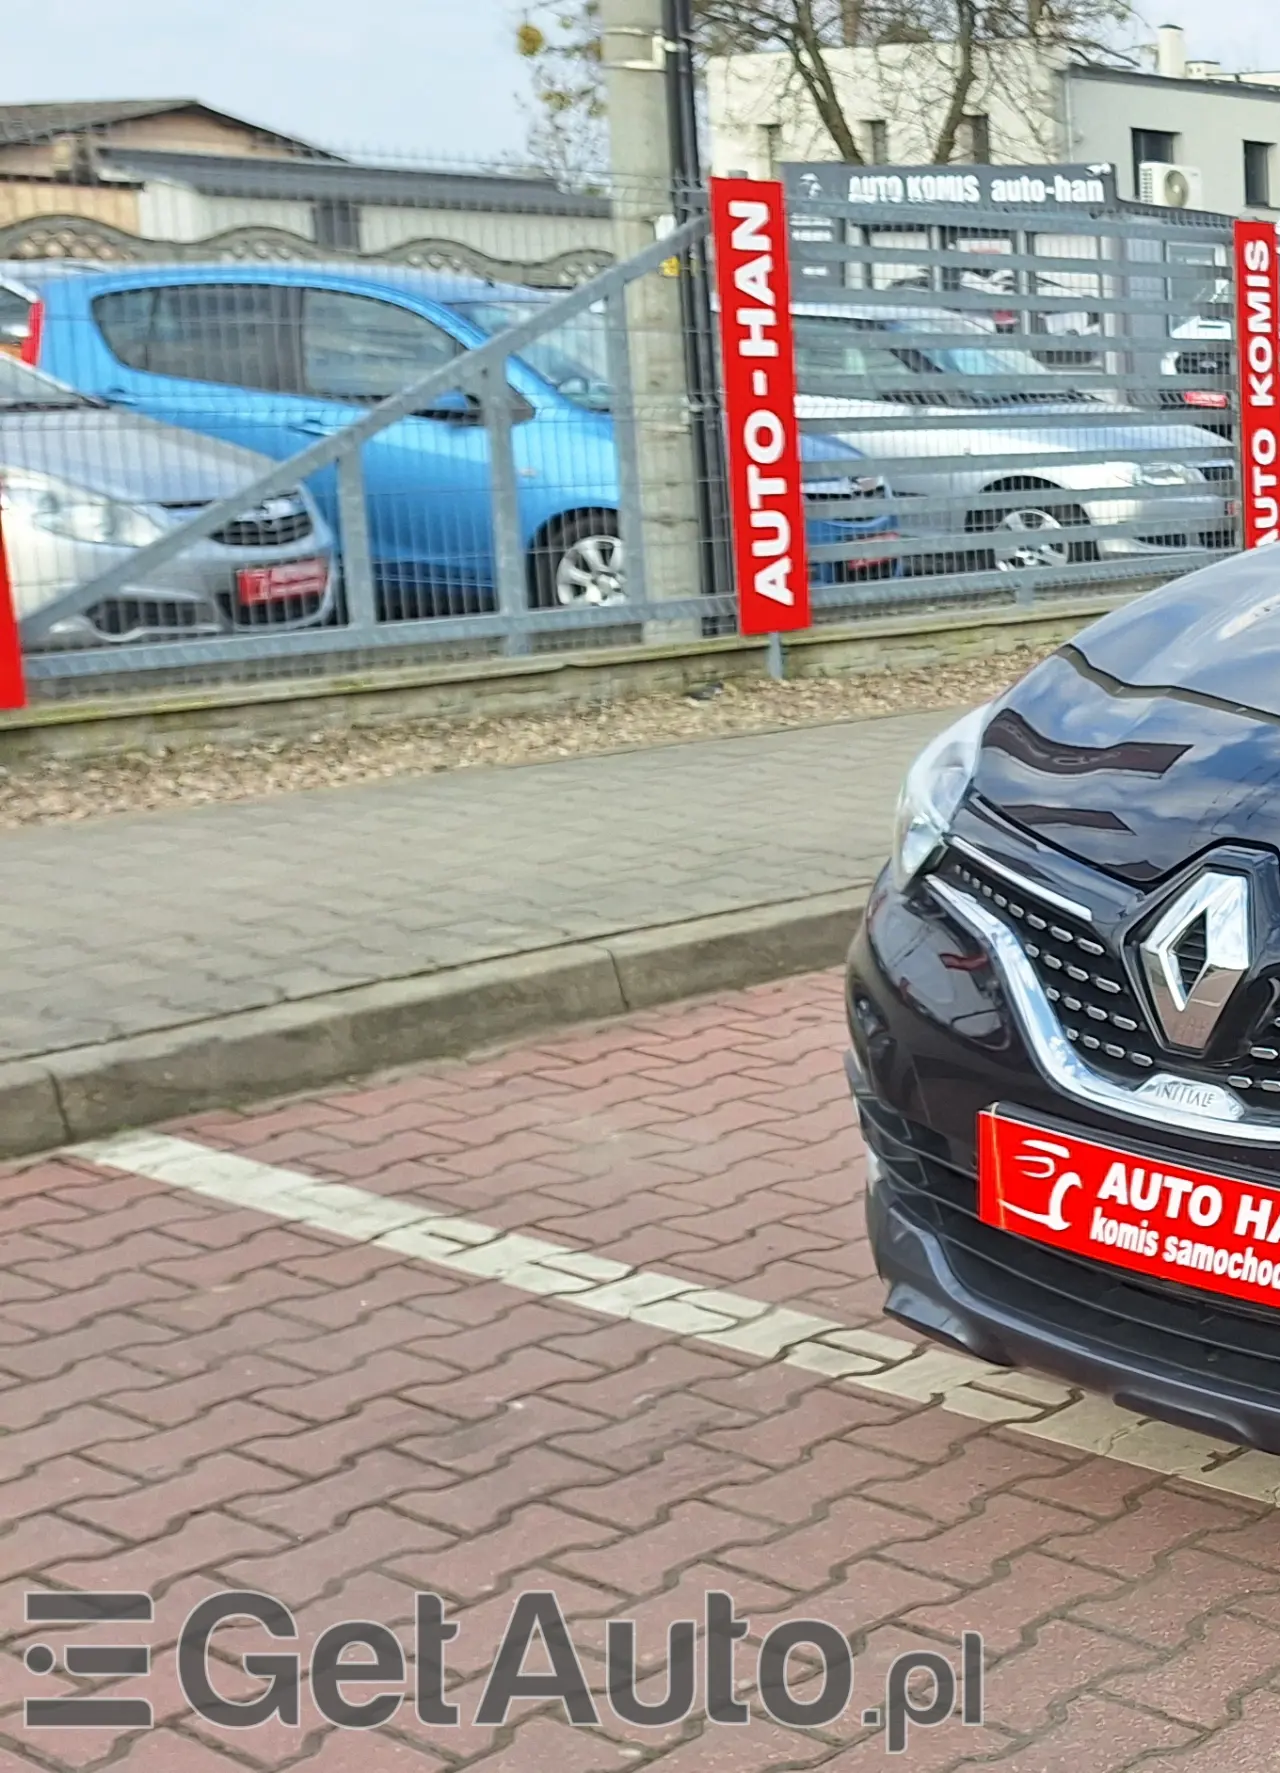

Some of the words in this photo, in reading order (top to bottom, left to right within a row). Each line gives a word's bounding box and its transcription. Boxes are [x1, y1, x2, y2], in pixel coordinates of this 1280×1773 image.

[848, 175, 904, 202] AUTO
[906, 175, 980, 202] KOMIS
[991, 175, 1104, 202] auto-han
[1244, 238, 1276, 407] KOMIS
[1155, 1083, 1216, 1108] INITIALE
[1096, 1161, 1223, 1228] AUTO
[1089, 1205, 1160, 1257] komis
